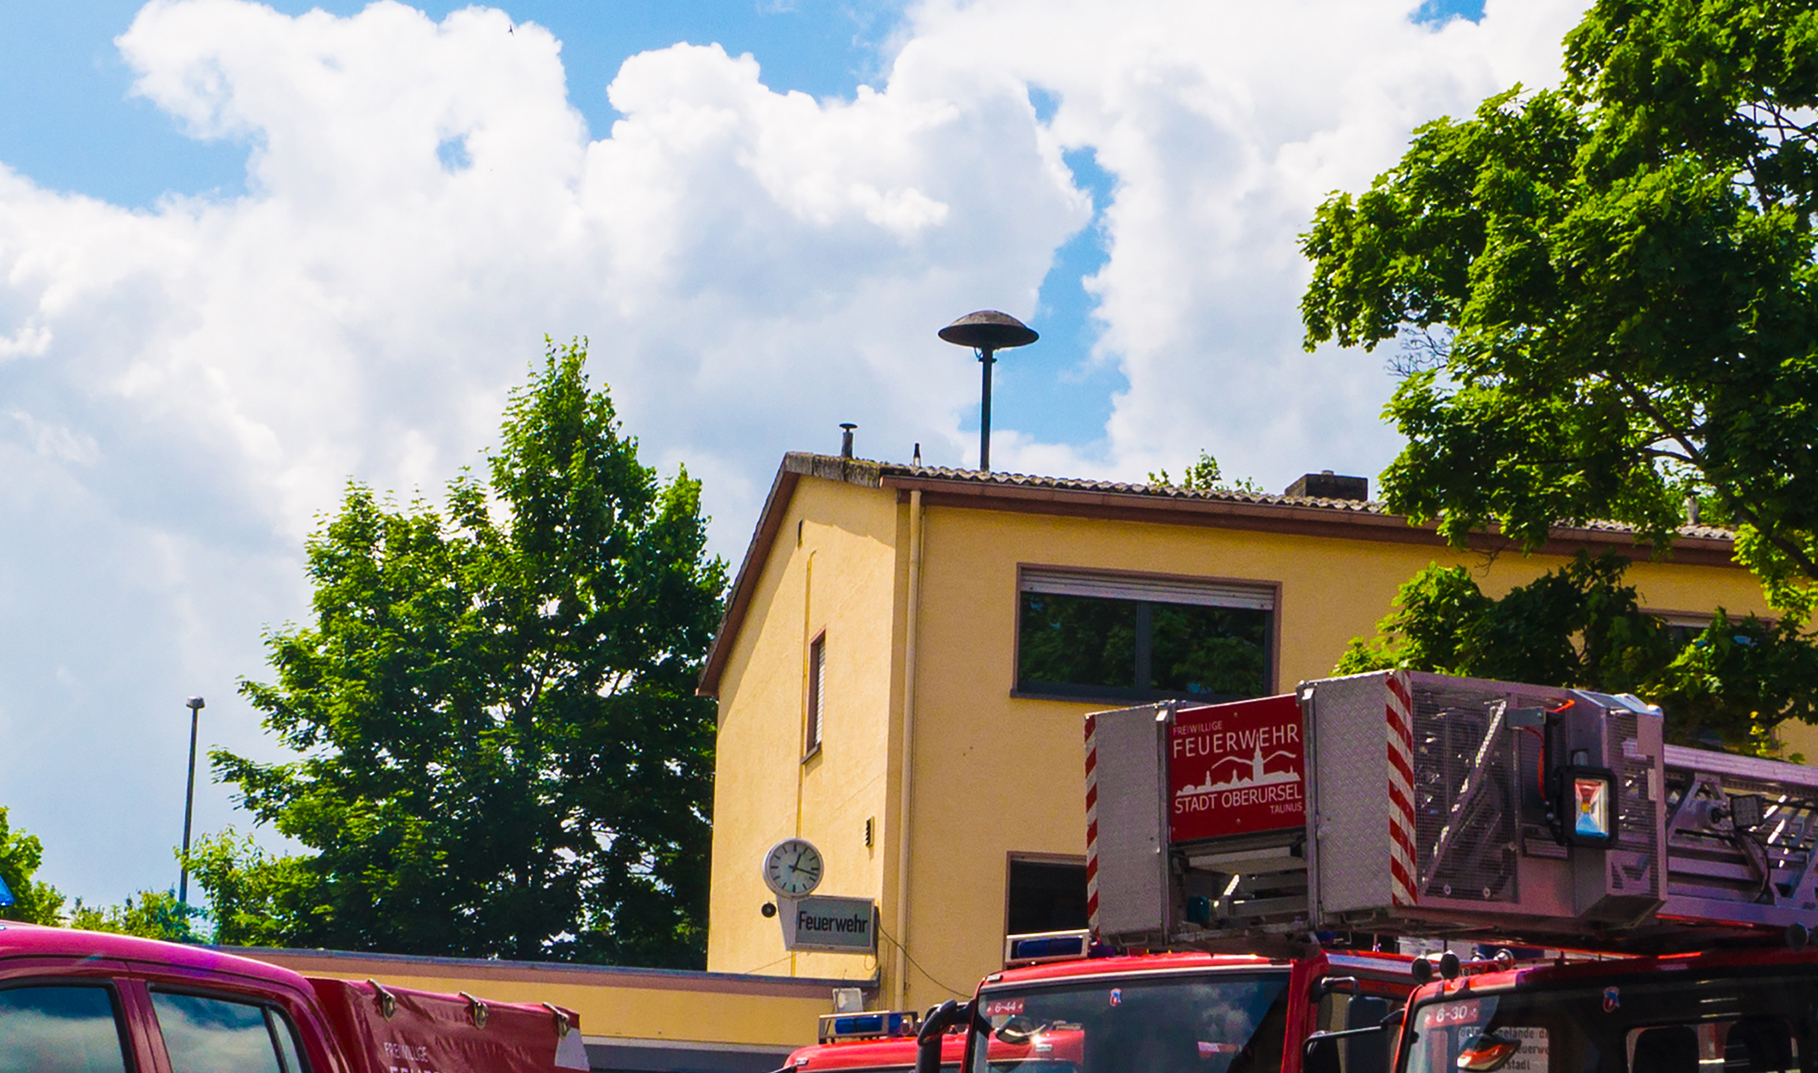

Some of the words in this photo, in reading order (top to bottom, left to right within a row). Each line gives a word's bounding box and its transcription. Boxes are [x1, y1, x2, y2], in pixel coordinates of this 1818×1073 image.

[1173, 720, 1223, 737] FREIWILLIGE
[1173, 723, 1300, 759] FEUERWEHR
[1174, 793, 1218, 814] STADT
[1221, 783, 1302, 809] OBERURSEL
[1269, 801, 1303, 815] TAUNUS
[798, 910, 868, 934] Feuerwehr
[1435, 1005, 1468, 1023] 6-30
